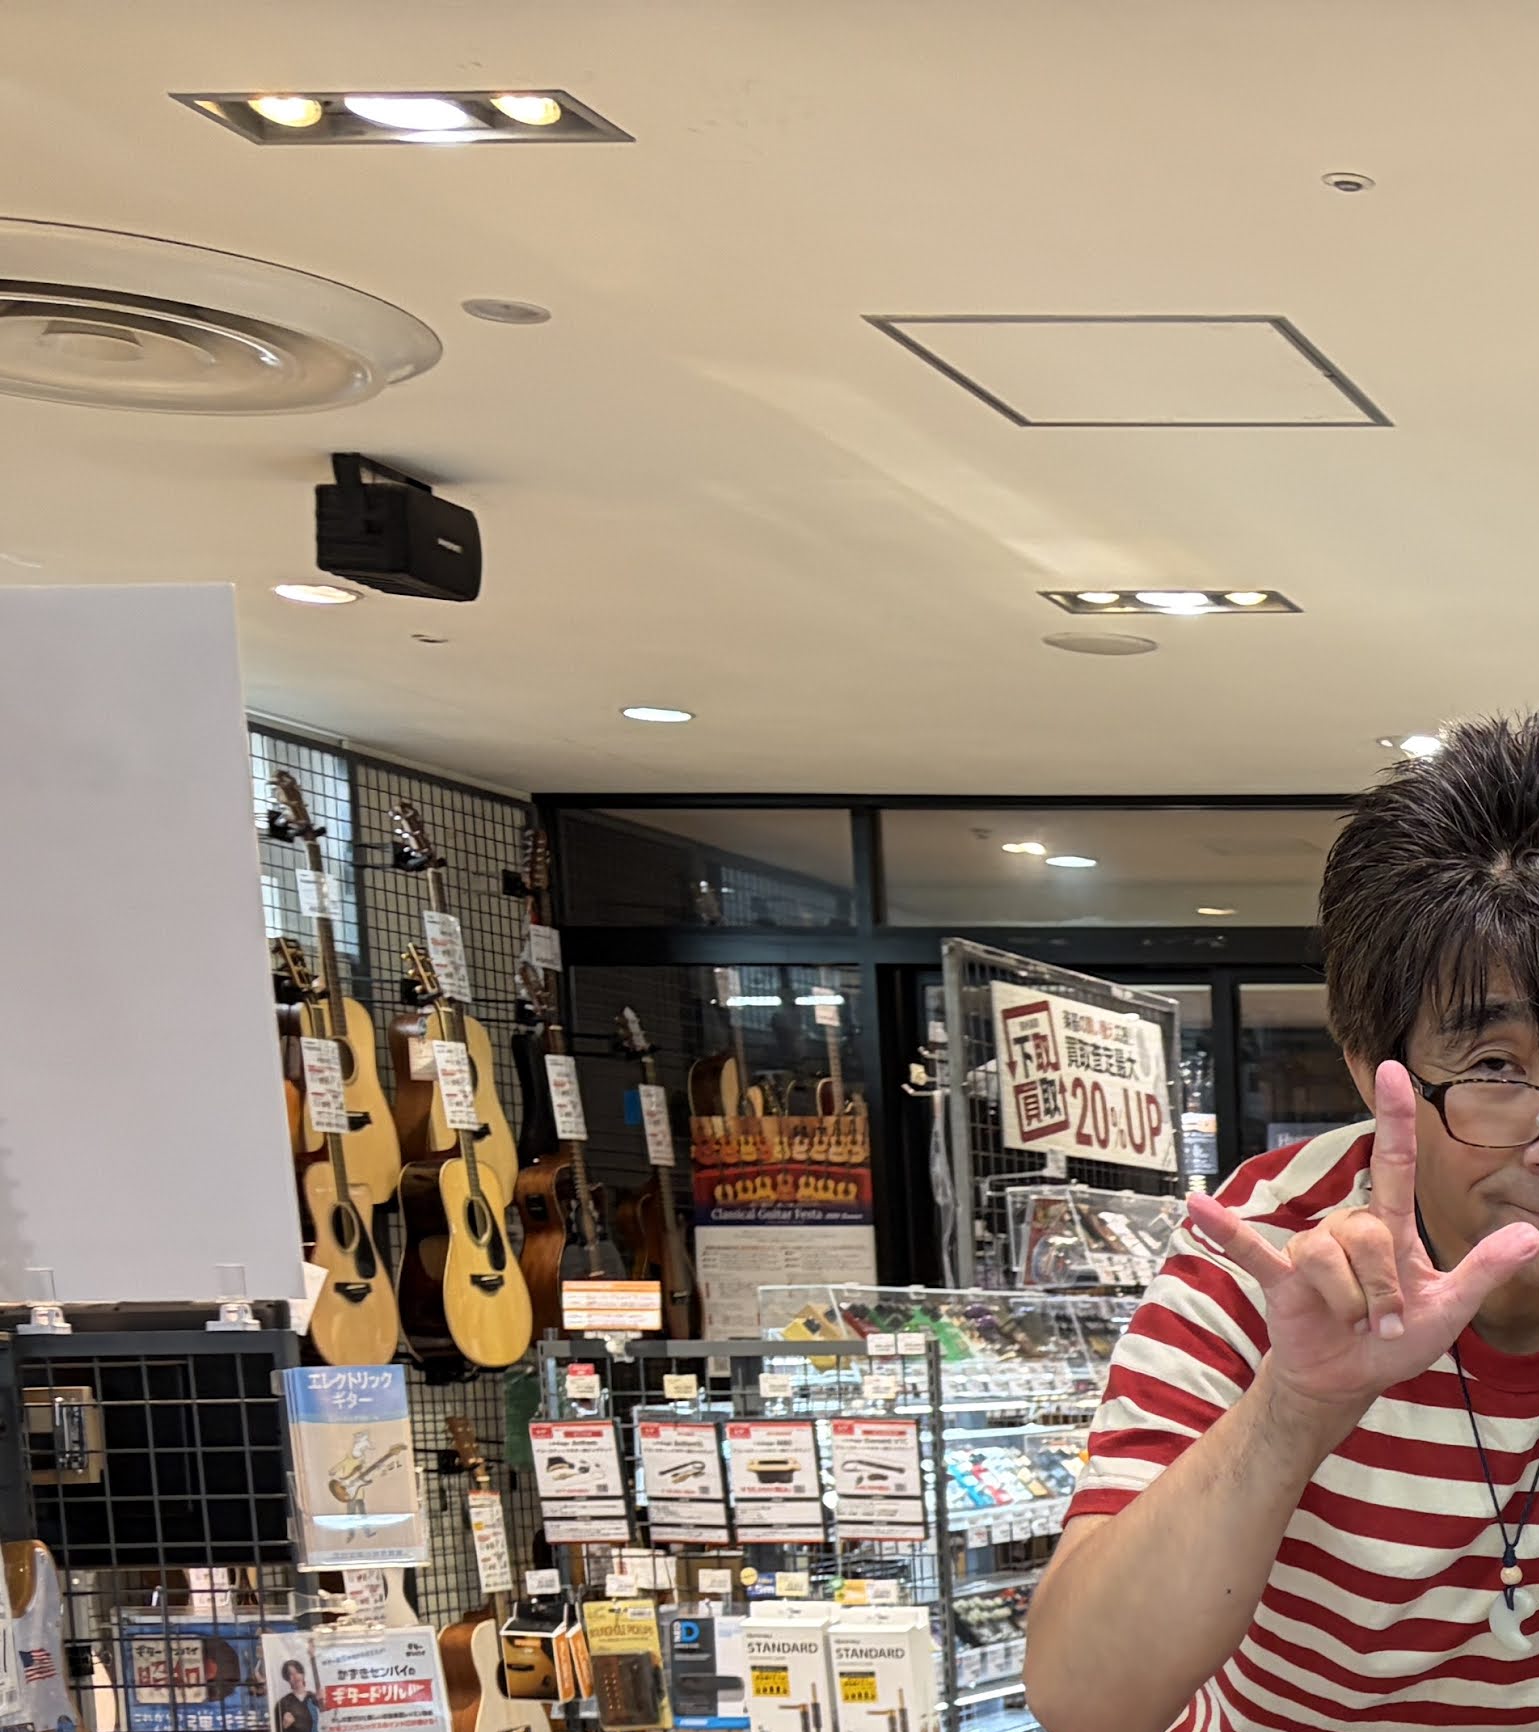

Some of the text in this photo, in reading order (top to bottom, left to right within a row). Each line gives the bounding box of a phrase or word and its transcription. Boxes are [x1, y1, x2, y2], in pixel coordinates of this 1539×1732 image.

[1013, 1033, 1061, 1079] 下取
[1016, 1077, 1062, 1126] 買取
[1071, 1077, 1162, 1156] 20%UP
[711, 1208, 755, 1220] Classical
[758, 1209, 792, 1220] Guitar
[307, 1372, 392, 1390] エレクトリック
[332, 1392, 373, 1409] ギター
[747, 1642, 818, 1654] STANDARD
[835, 1648, 905, 1659] STANDARD
[337, 1665, 416, 1680] かずきセンパイの
[332, 1685, 410, 1705] ギタードリル
